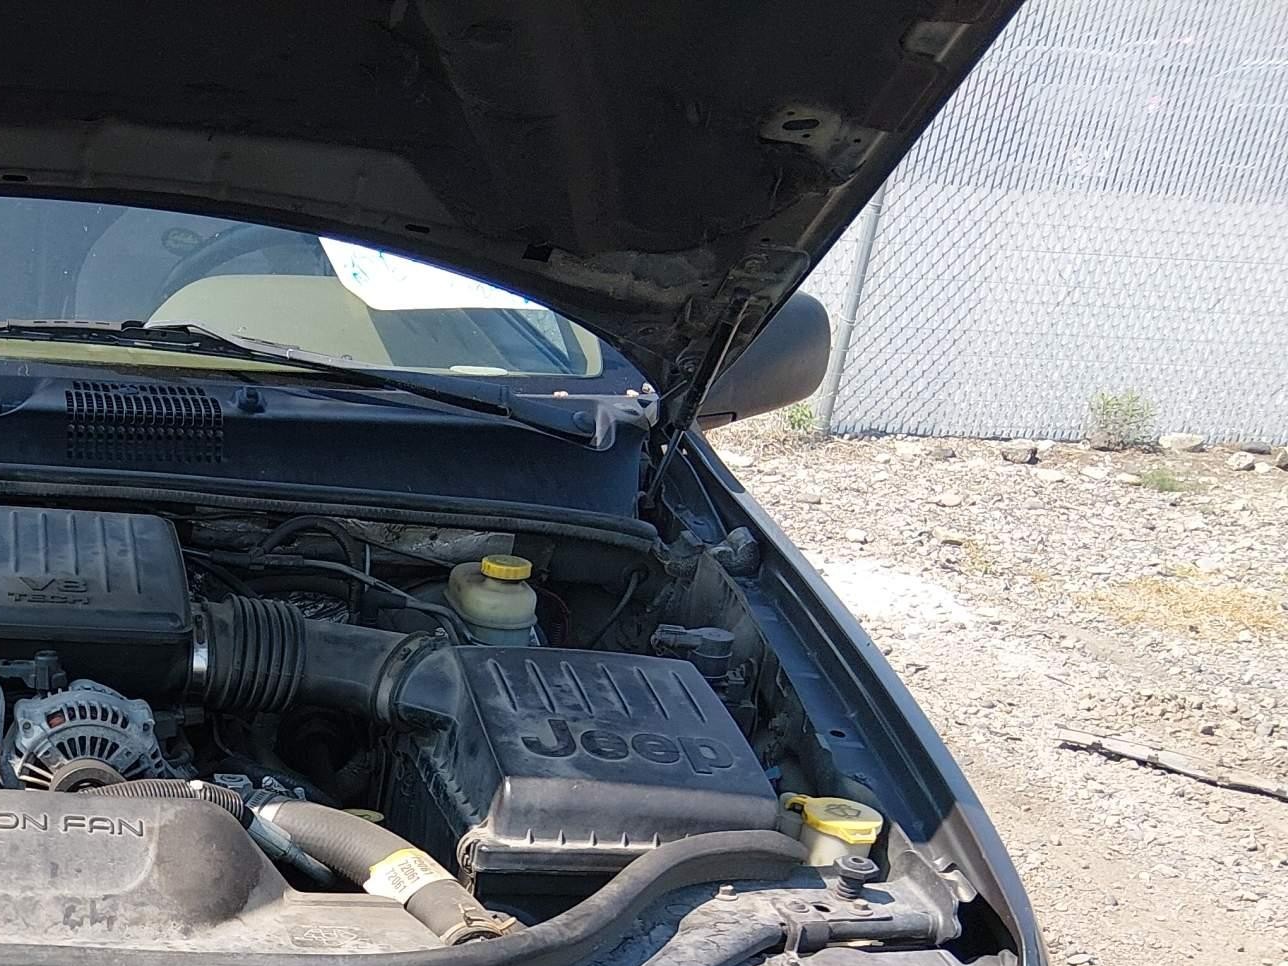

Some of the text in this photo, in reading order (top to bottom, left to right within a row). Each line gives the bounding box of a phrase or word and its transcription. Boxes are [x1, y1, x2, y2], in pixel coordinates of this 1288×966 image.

[18, 575, 90, 593] V8
[7, 591, 90, 605] TECH
[521, 718, 737, 776] Jeep
[62, 814, 145, 838] FAN
[385, 867, 408, 894] 72061
[398, 860, 421, 884] 72061
